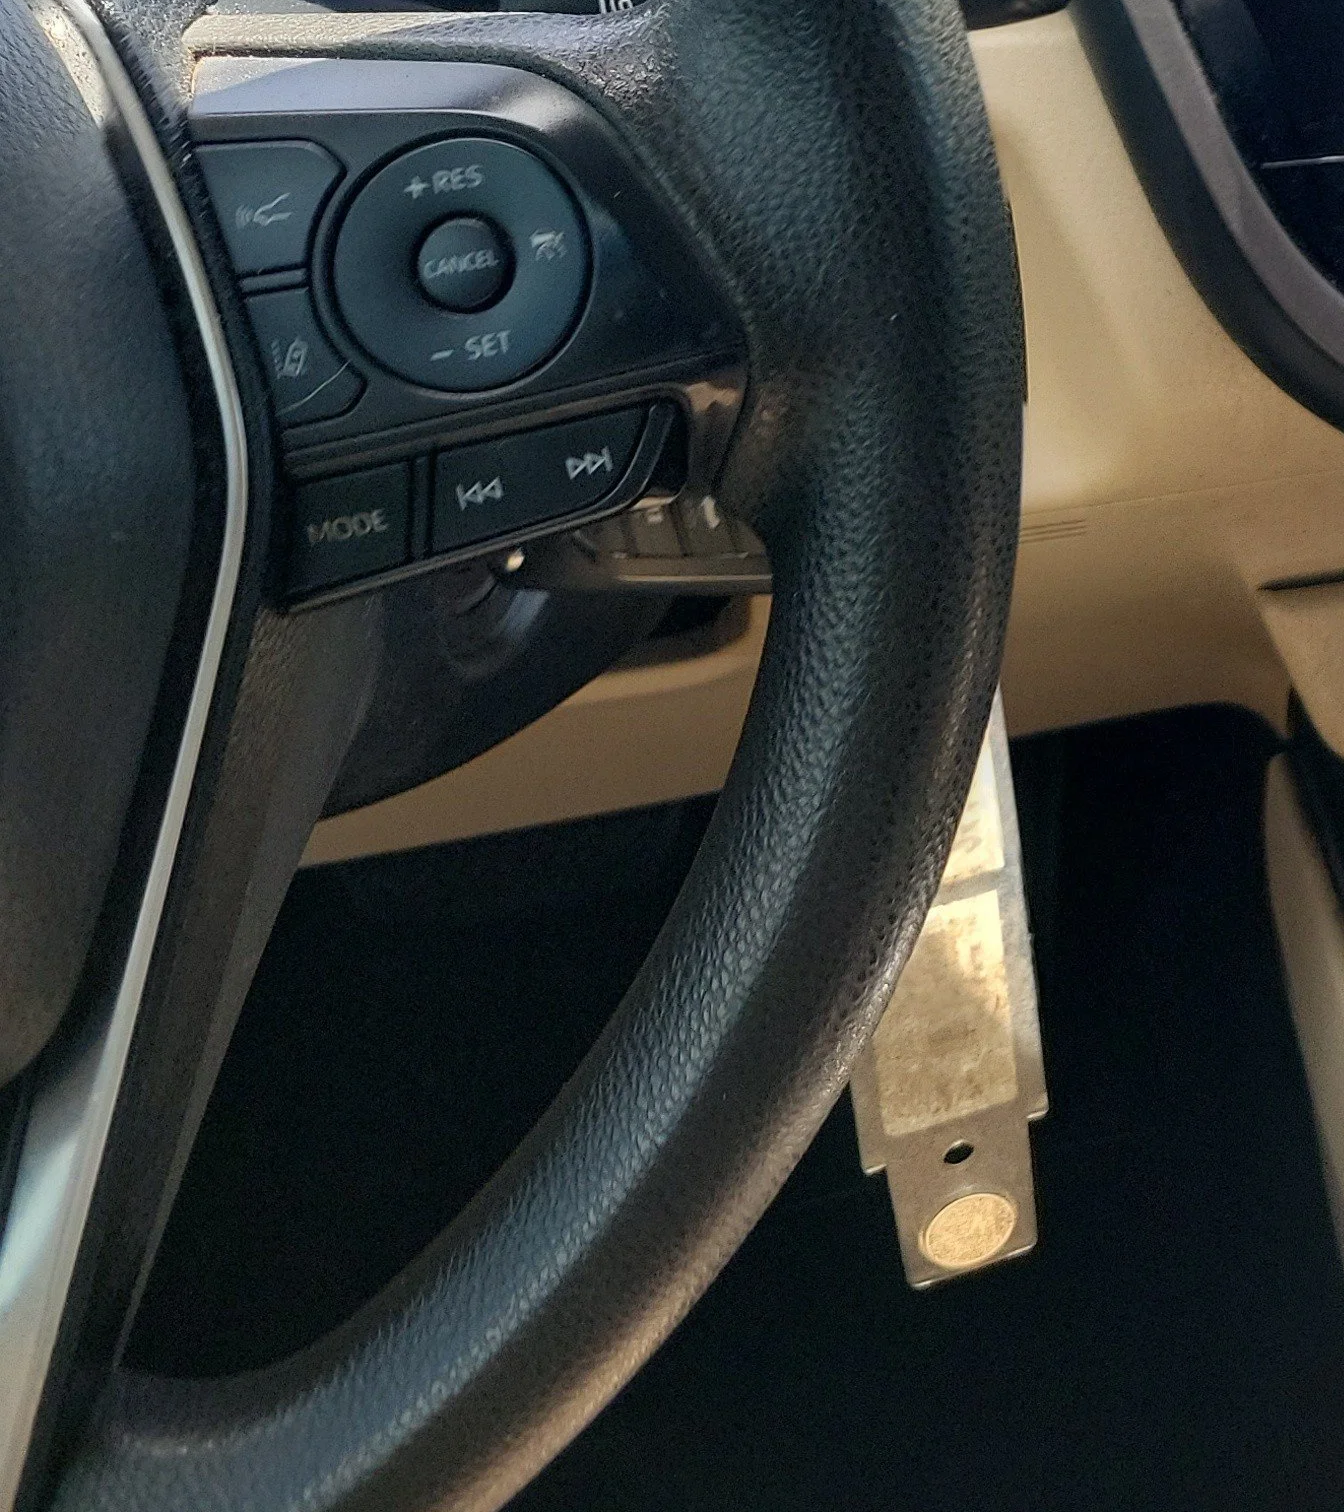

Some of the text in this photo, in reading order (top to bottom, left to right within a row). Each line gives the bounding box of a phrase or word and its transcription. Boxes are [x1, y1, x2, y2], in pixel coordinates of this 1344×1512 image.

[424, 249, 500, 280] CANCEL
[465, 330, 513, 361] SET
[306, 508, 389, 545] MODE
